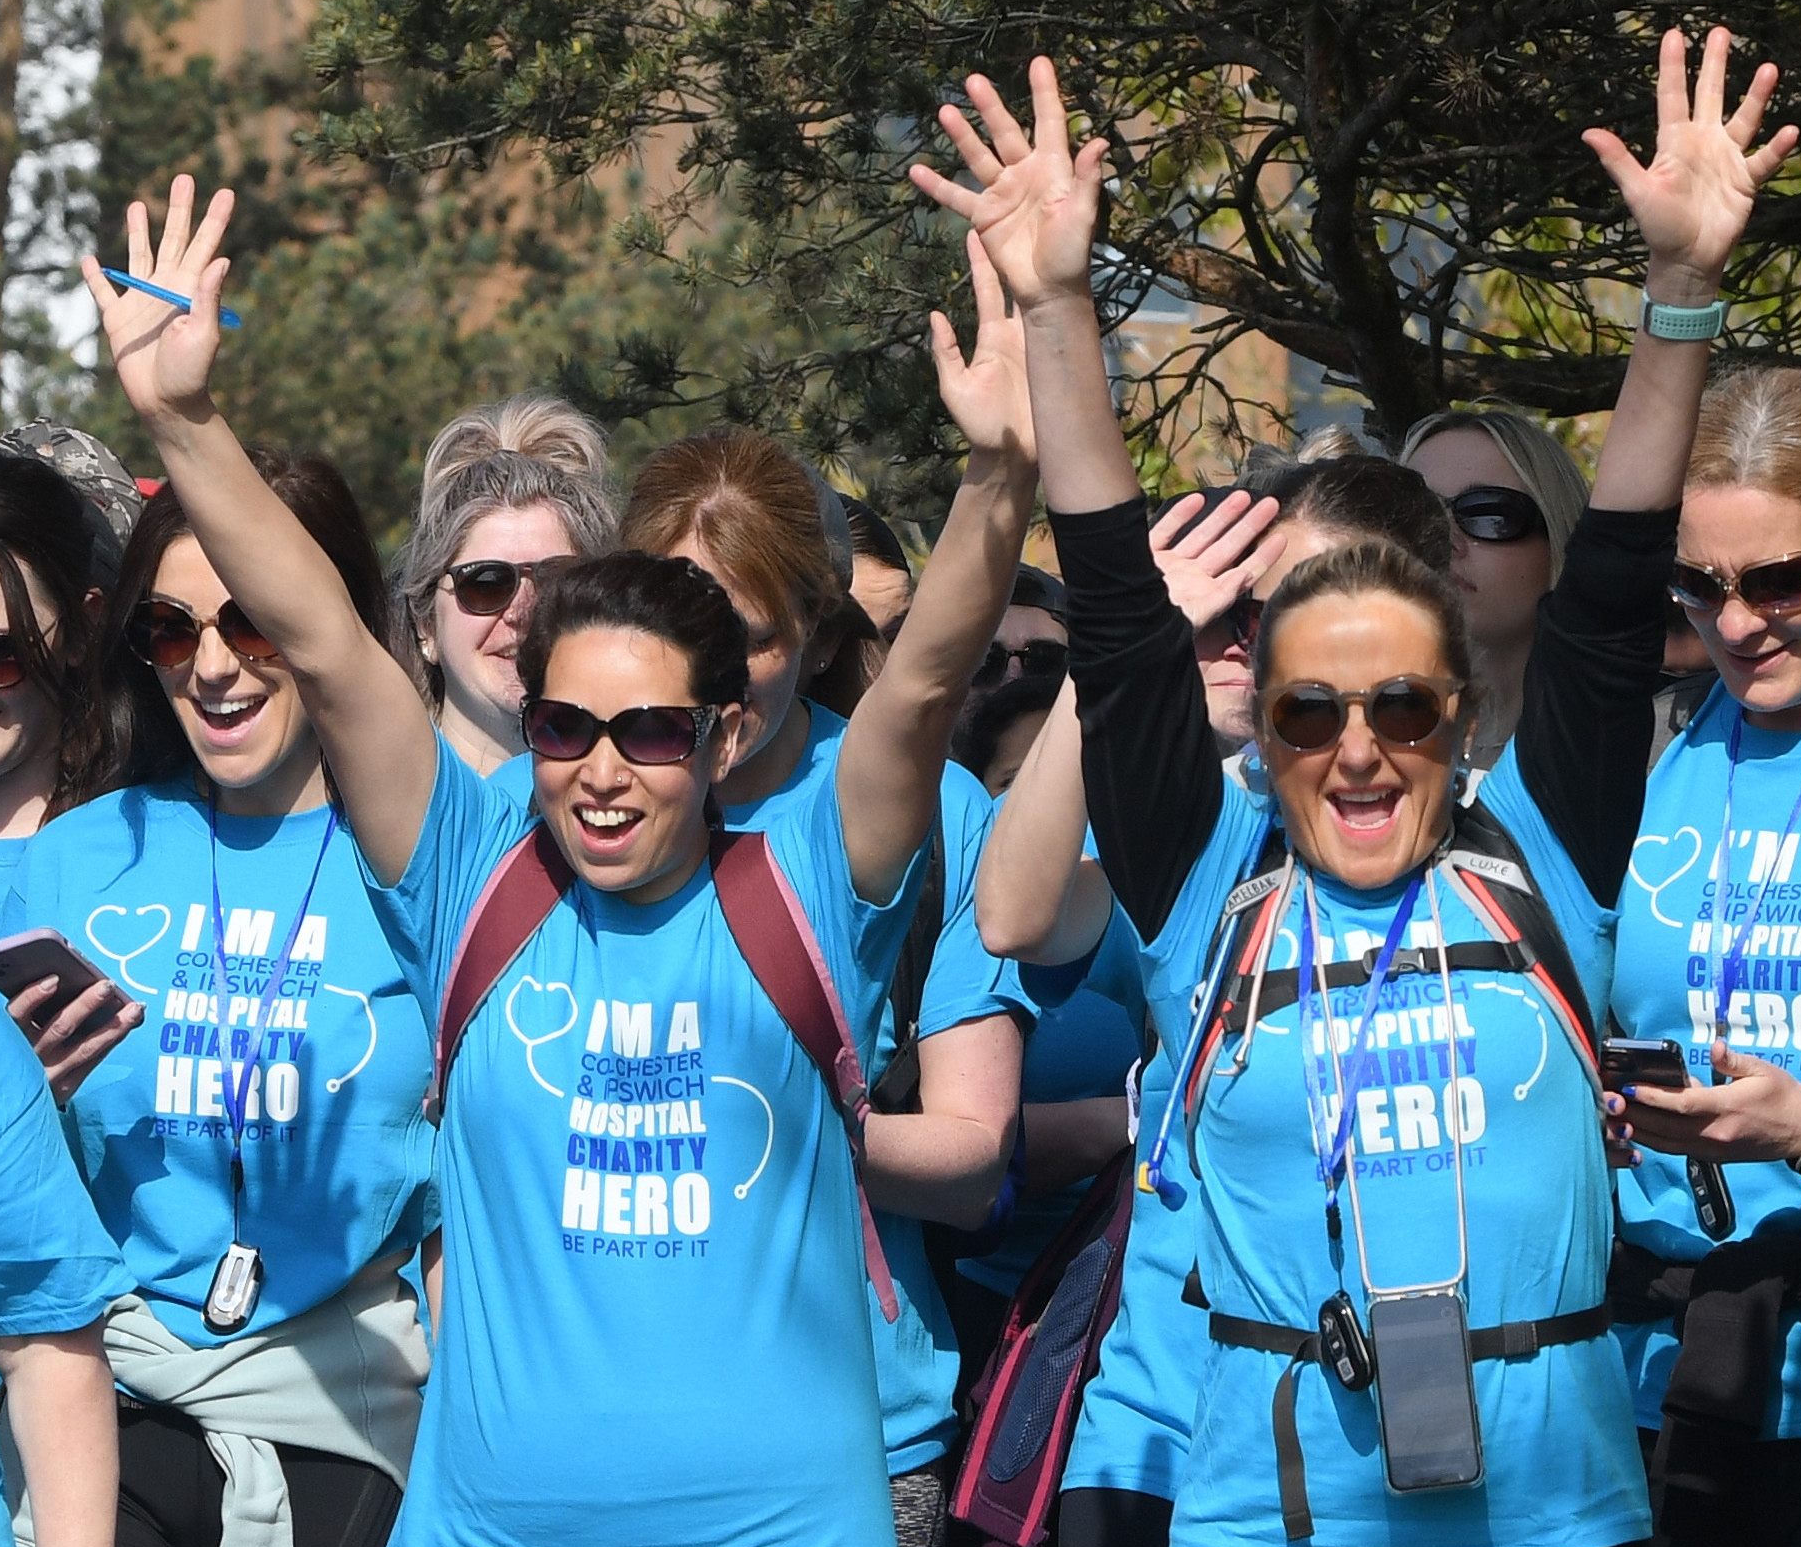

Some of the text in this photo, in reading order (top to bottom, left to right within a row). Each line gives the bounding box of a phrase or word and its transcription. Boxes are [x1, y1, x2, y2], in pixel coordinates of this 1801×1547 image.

[1470, 857, 1509, 876] LUXE
[1224, 877, 1276, 915] AMELBAK
[1697, 901, 1713, 921] &
[289, 914, 327, 961] A
[171, 970, 188, 989] &
[159, 1022, 306, 1061] CHARTY
[667, 1001, 701, 1054] A
[1689, 1048, 1710, 1066] BE
[1771, 1053, 1794, 1070] OF
[155, 1055, 300, 1122] HERO
[576, 1074, 705, 1103] & IPSWICH
[154, 1118, 178, 1136] BE
[246, 1124, 273, 1141] OF
[279, 1126, 297, 1142] IT
[569, 1097, 706, 1138] HOSPITAL
[1308, 1077, 1486, 1156] HERO
[567, 1133, 707, 1173] CHARITY
[1355, 1156, 1416, 1180] PART
[1425, 1152, 1456, 1172] OF
[1467, 1146, 1487, 1167] IT
[562, 1167, 711, 1236] HERO
[562, 1233, 709, 1258] BE PART OF IT
